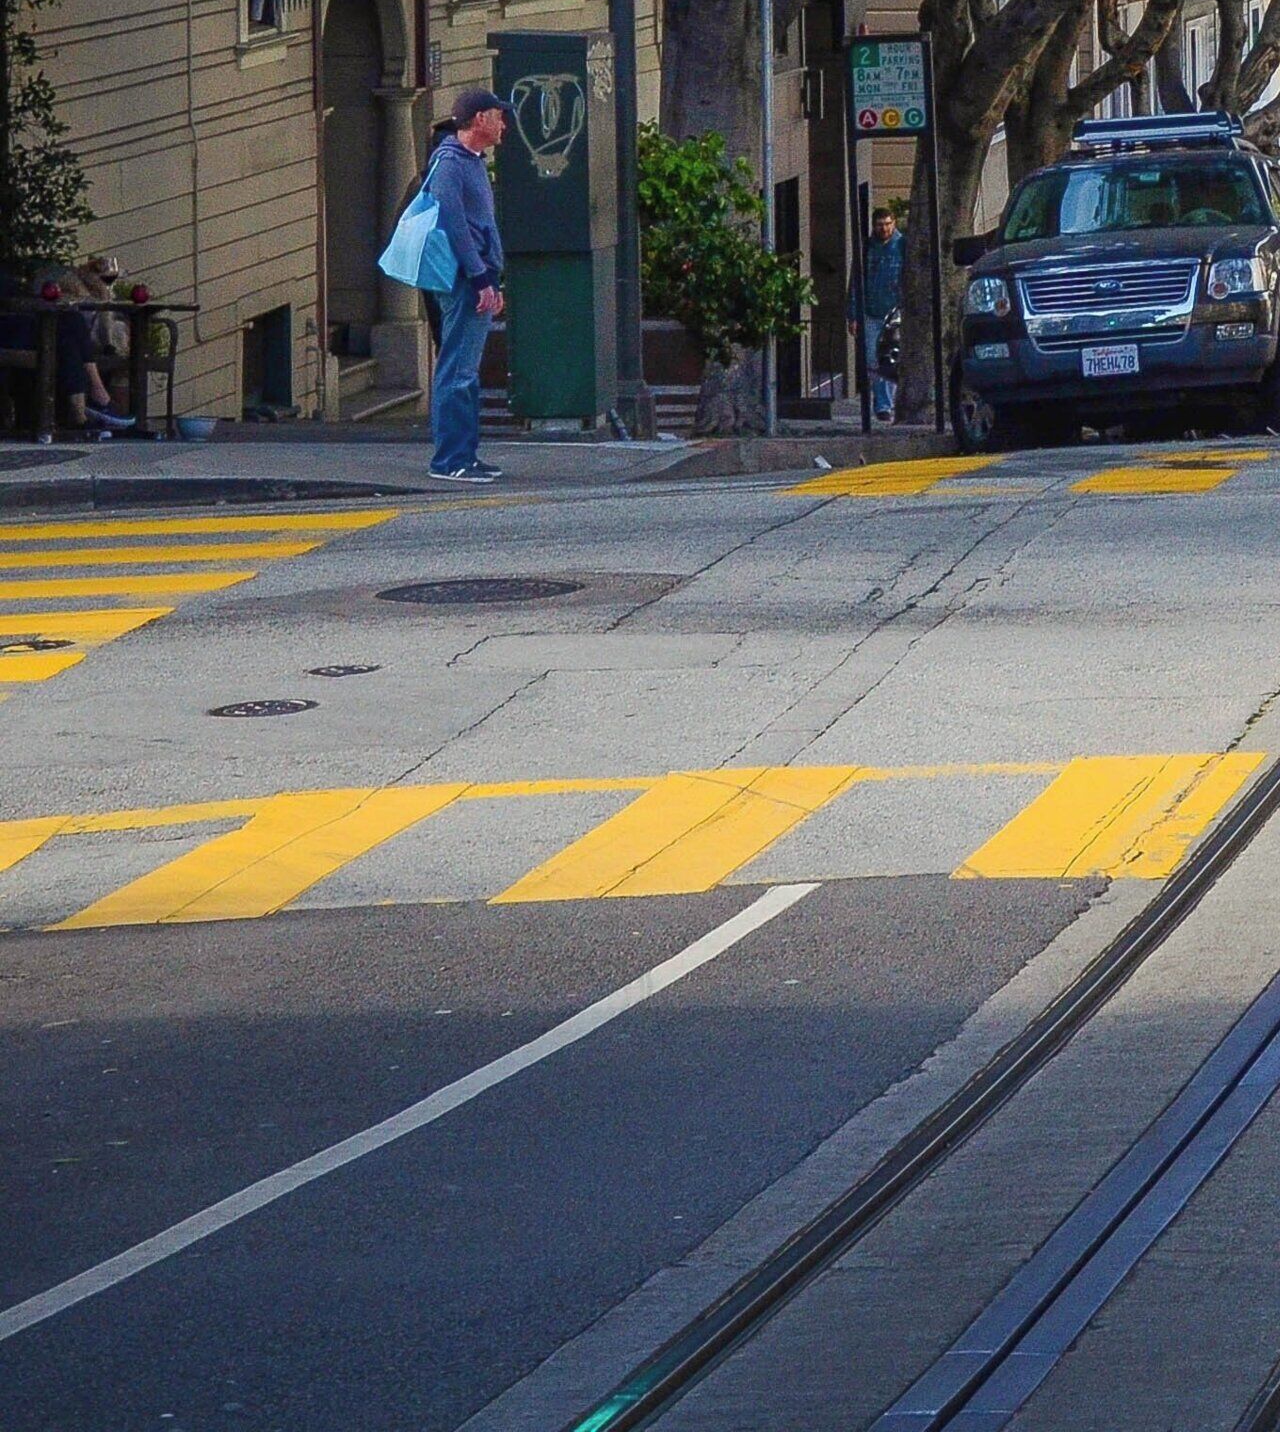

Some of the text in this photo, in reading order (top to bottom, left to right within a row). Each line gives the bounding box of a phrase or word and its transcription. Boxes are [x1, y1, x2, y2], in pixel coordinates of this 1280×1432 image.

[860, 47, 870, 65] 2
[881, 55, 920, 65] PARKING
[859, 84, 880, 93] MON
[862, 111, 919, 125] A C G
[1086, 355, 1136, 373] 7HEH478
